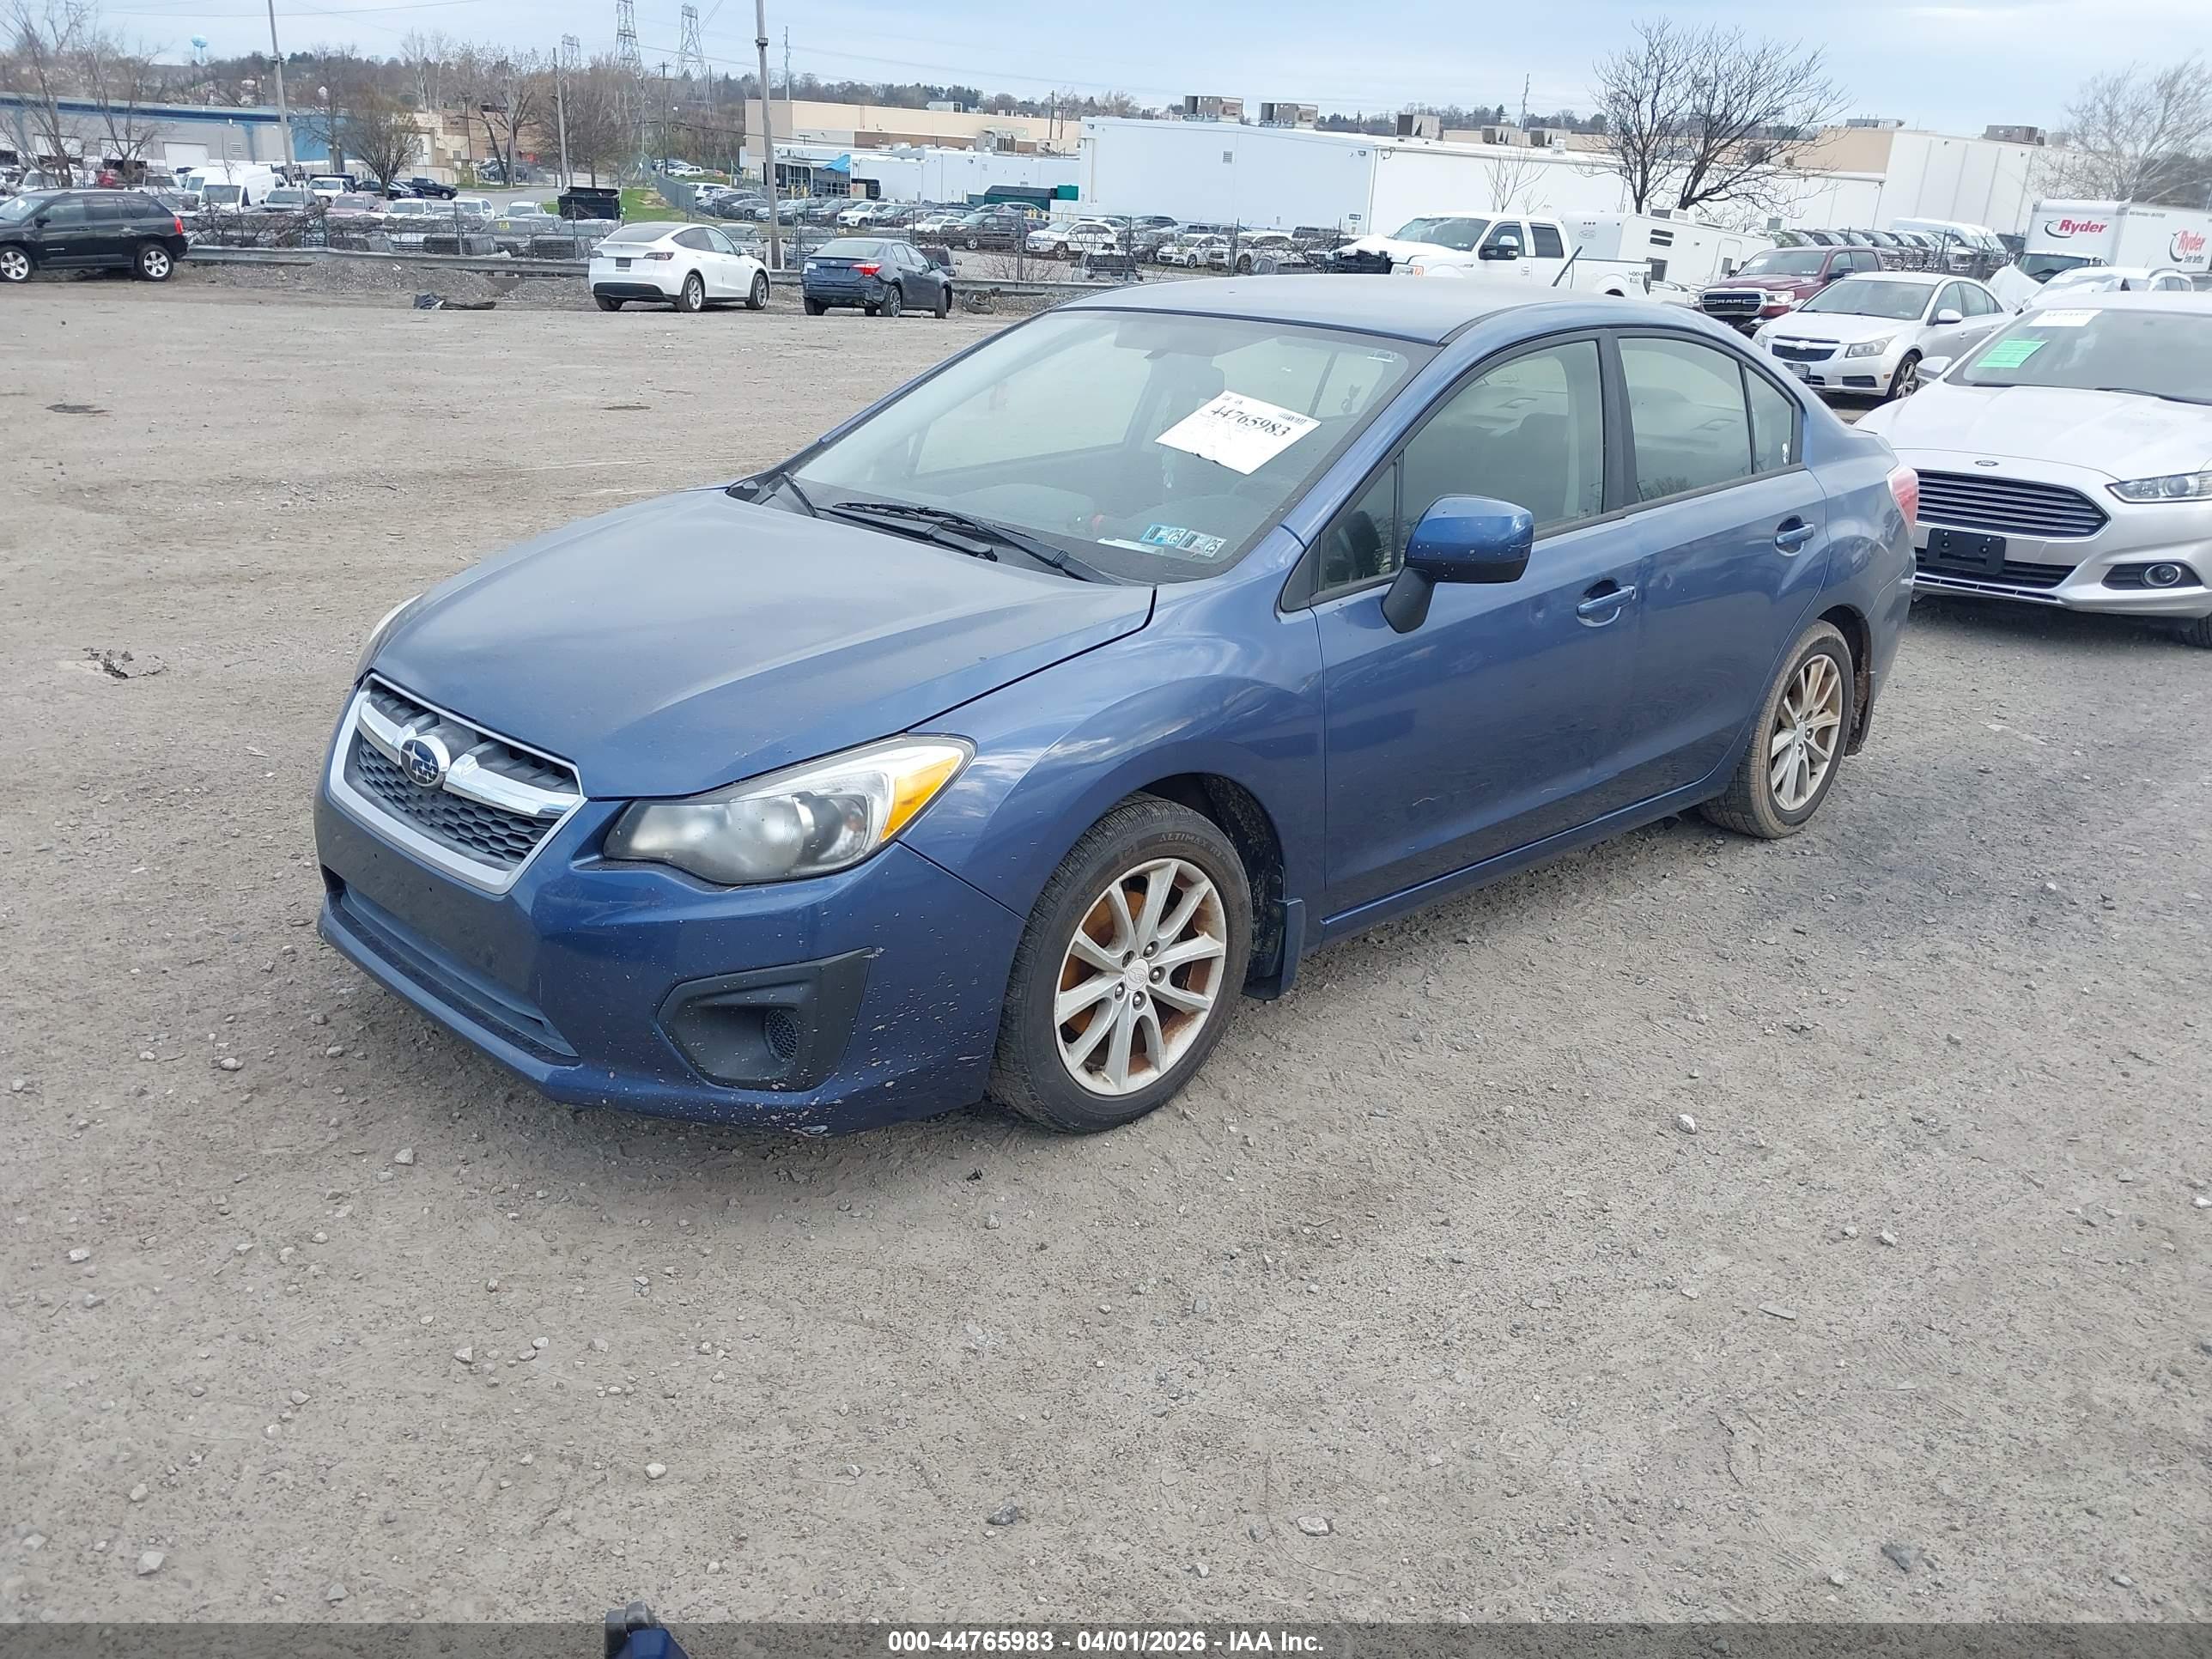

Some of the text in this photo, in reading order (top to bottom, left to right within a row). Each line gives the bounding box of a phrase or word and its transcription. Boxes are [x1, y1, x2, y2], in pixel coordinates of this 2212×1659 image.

[2057, 219, 2108, 234] Ryder
[2177, 230, 2206, 255] Ryder
[1211, 405, 1291, 437] 44765983
[1159, 832, 1209, 848] ALTIMAX
